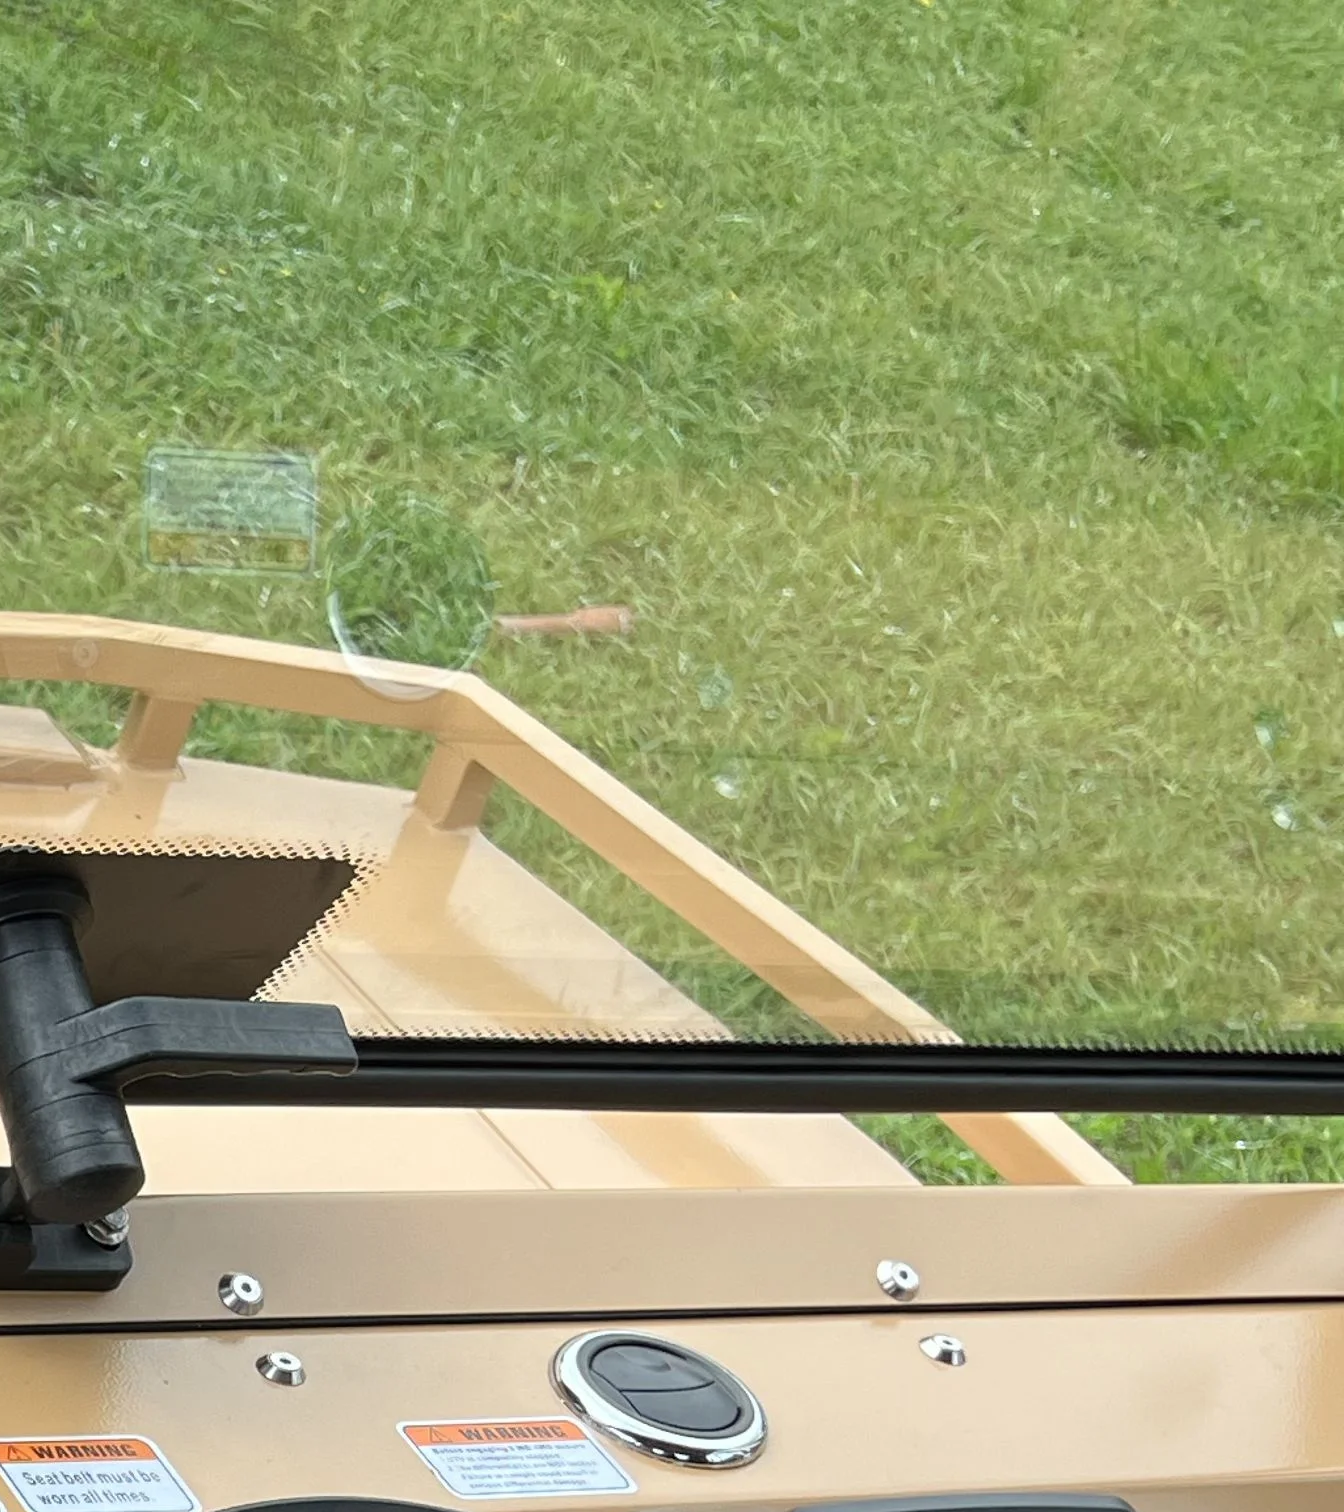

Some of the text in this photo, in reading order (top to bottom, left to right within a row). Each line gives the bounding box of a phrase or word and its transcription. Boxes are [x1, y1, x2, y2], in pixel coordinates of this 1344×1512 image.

[459, 1425, 568, 1441] WARNING
[31, 1443, 139, 1460] WARNING
[22, 1469, 160, 1486] Seat belt must be
[36, 1493, 77, 1505] worn
[80, 1489, 102, 1504] all
